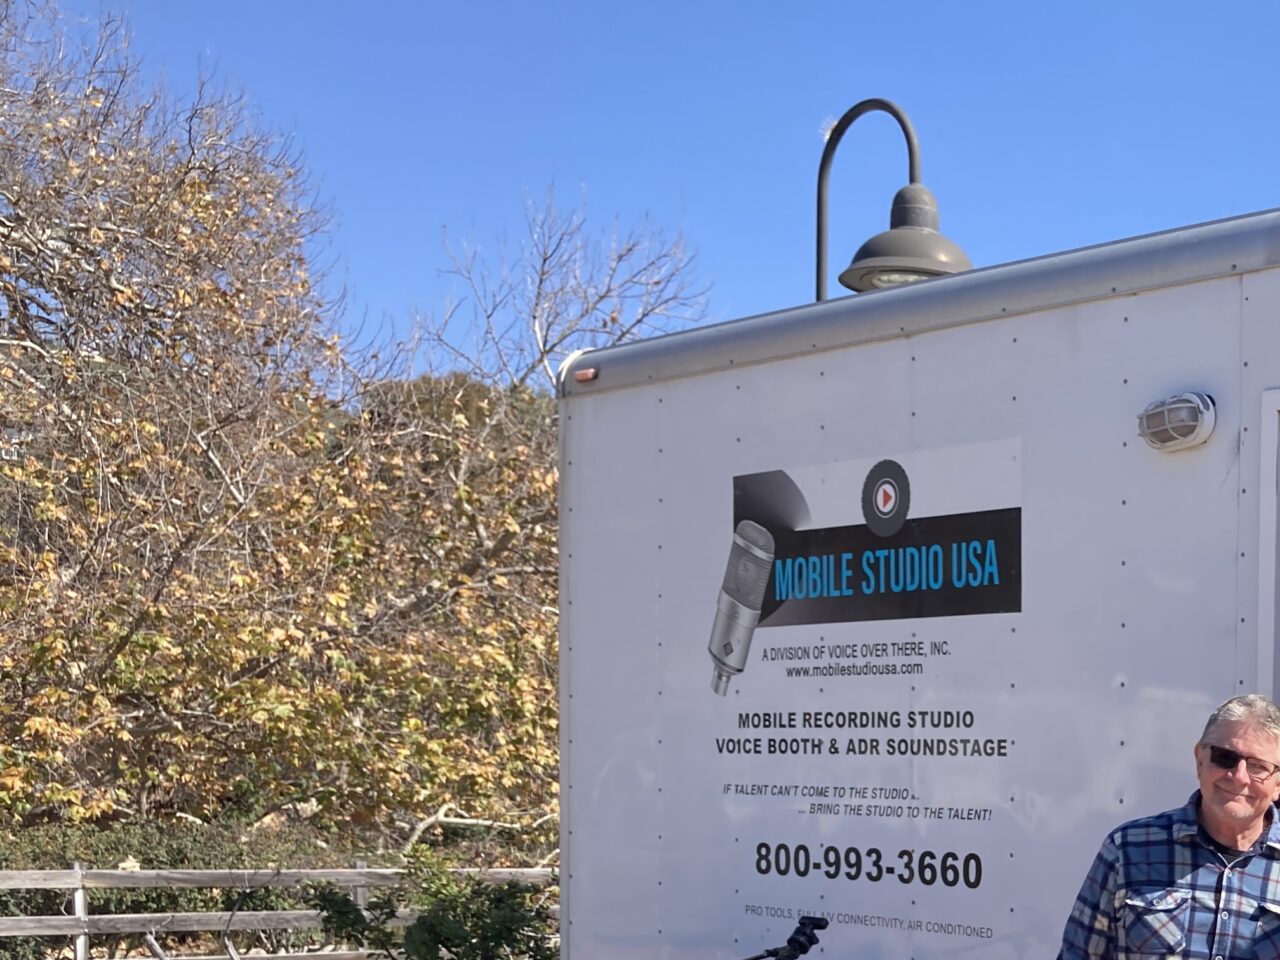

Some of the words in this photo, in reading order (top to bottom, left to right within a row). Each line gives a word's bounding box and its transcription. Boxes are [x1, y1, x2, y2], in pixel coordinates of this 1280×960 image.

[774, 552, 853, 601] MOBILE
[861, 544, 944, 595] STUDIO
[951, 539, 1000, 589] USA
[762, 648, 769, 661] A
[770, 646, 810, 661] DIVISION
[812, 645, 826, 660] OF
[827, 643, 858, 659] VOICE
[860, 642, 889, 658] OVER
[890, 641, 927, 658] THERE,
[930, 640, 952, 656] INC.
[785, 661, 923, 677] www.mobilestudiousa.com
[738, 712, 797, 729] MOBILE
[802, 711, 901, 728] RECORDING
[907, 710, 975, 728] STUDIO
[715, 738, 762, 754] VOICE
[768, 738, 822, 754] BOOTH
[828, 738, 840, 754] &
[846, 738, 880, 755] ADR
[886, 738, 1008, 757] SOUNDSTAGE
[723, 783, 732, 794] IF
[734, 784, 769, 796] TALENT
[770, 785, 800, 797] CAN'T
[801, 785, 830, 798] COME
[833, 786, 846, 799] TO
[849, 787, 869, 799] THE
[809, 803, 841, 815] BRING
[843, 804, 863, 816] THE
[865, 805, 904, 818] STUDIO
[906, 806, 920, 818] TO
[923, 807, 945, 819] THE
[947, 807, 992, 821] TALENT!
[755, 841, 983, 889] 800-993-3660
[745, 904, 763, 917] PRO
[764, 906, 795, 920] TOOLS,
[836, 912, 906, 930] CONNECTIVITY,
[907, 919, 923, 931] AIR
[925, 921, 993, 939] CONDITIONED
